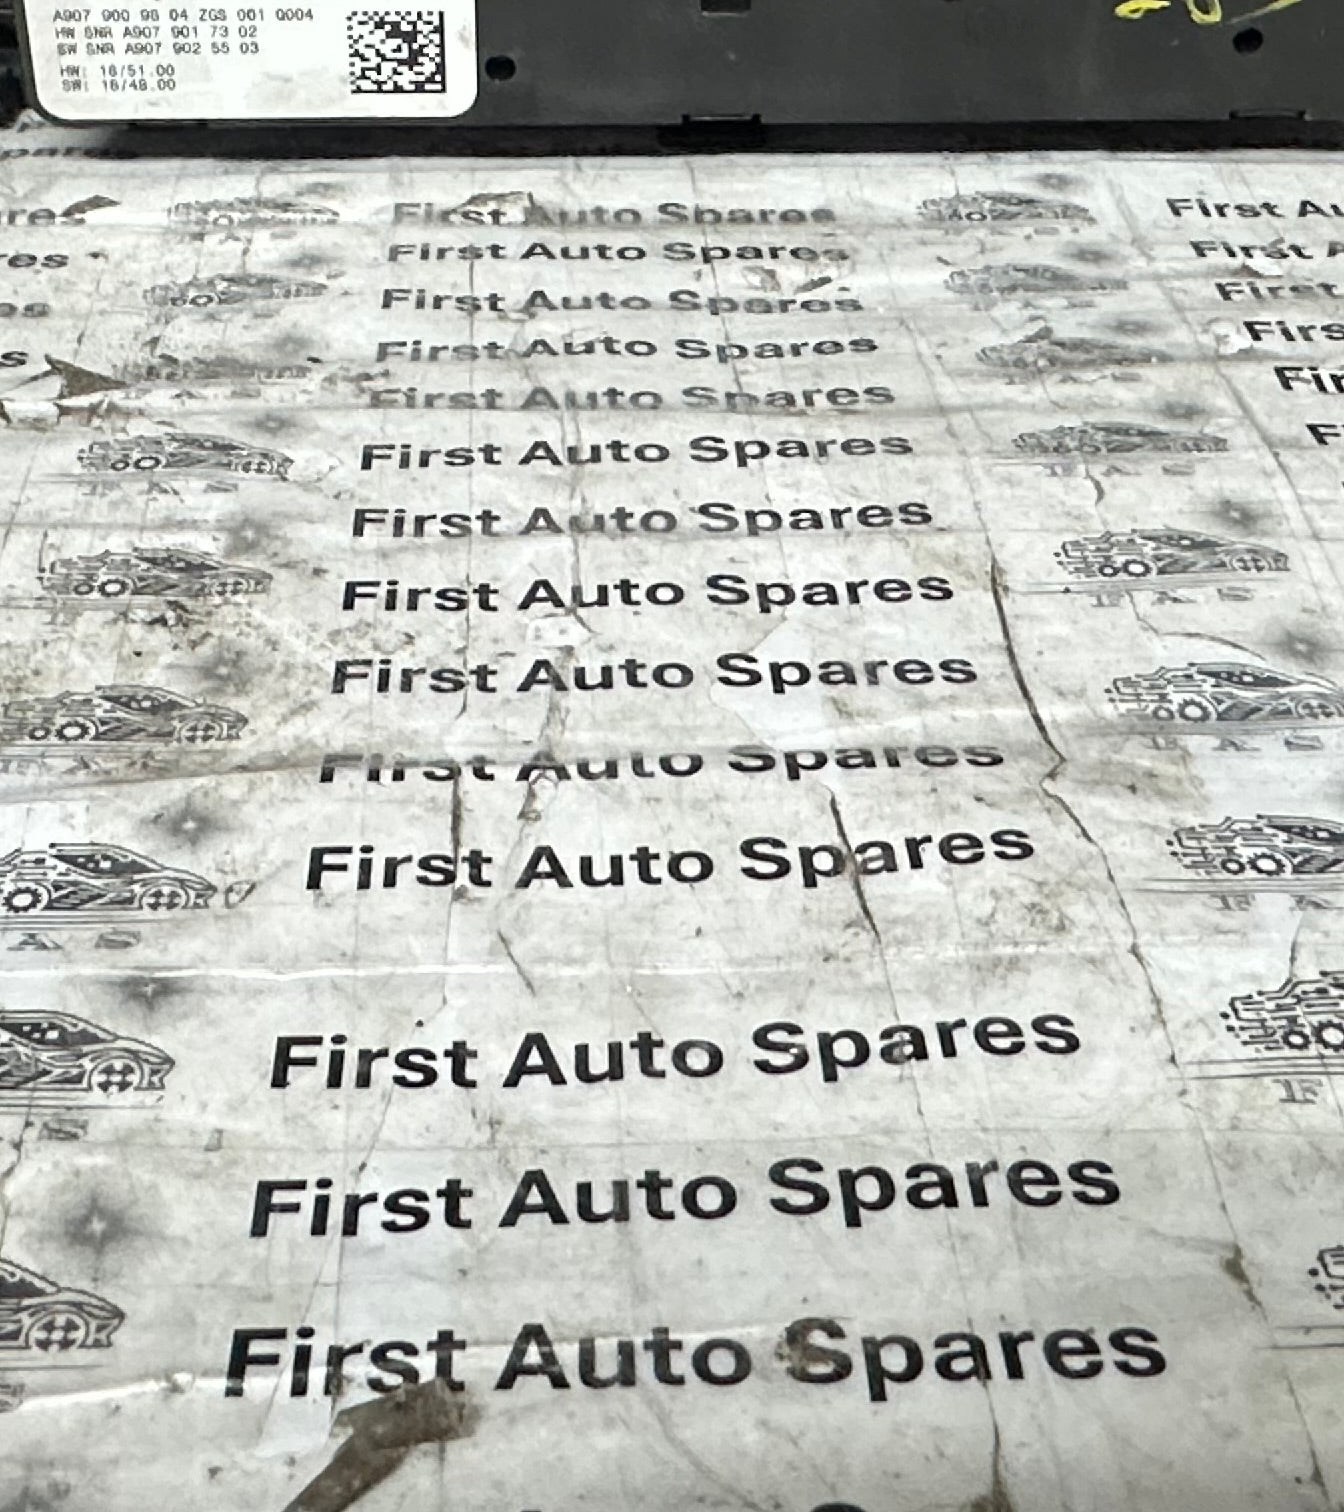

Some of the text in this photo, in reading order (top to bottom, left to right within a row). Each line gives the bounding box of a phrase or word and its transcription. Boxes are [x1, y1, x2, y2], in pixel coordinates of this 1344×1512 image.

[53, 9, 90, 22] A907
[170, 9, 188, 21] 04
[199, 9, 227, 21] ZGS
[237, 8, 265, 21] 001
[123, 26, 160, 38] A907
[171, 26, 199, 38] 901
[210, 26, 229, 38] 73
[238, 26, 257, 38] 02
[125, 42, 162, 54] A907
[172, 42, 202, 54] 902
[239, 42, 259, 54] 03
[387, 242, 851, 264] First Auto Spares
[360, 433, 914, 470] First Auto Spares
[342, 574, 954, 613] First Auto Spares
[307, 828, 1036, 891] First Auto Spares
[271, 1010, 1081, 1090] First Auto Spares
[249, 1154, 1121, 1239] First Auto Spares
[223, 1316, 1168, 1402] First Auto Spares
